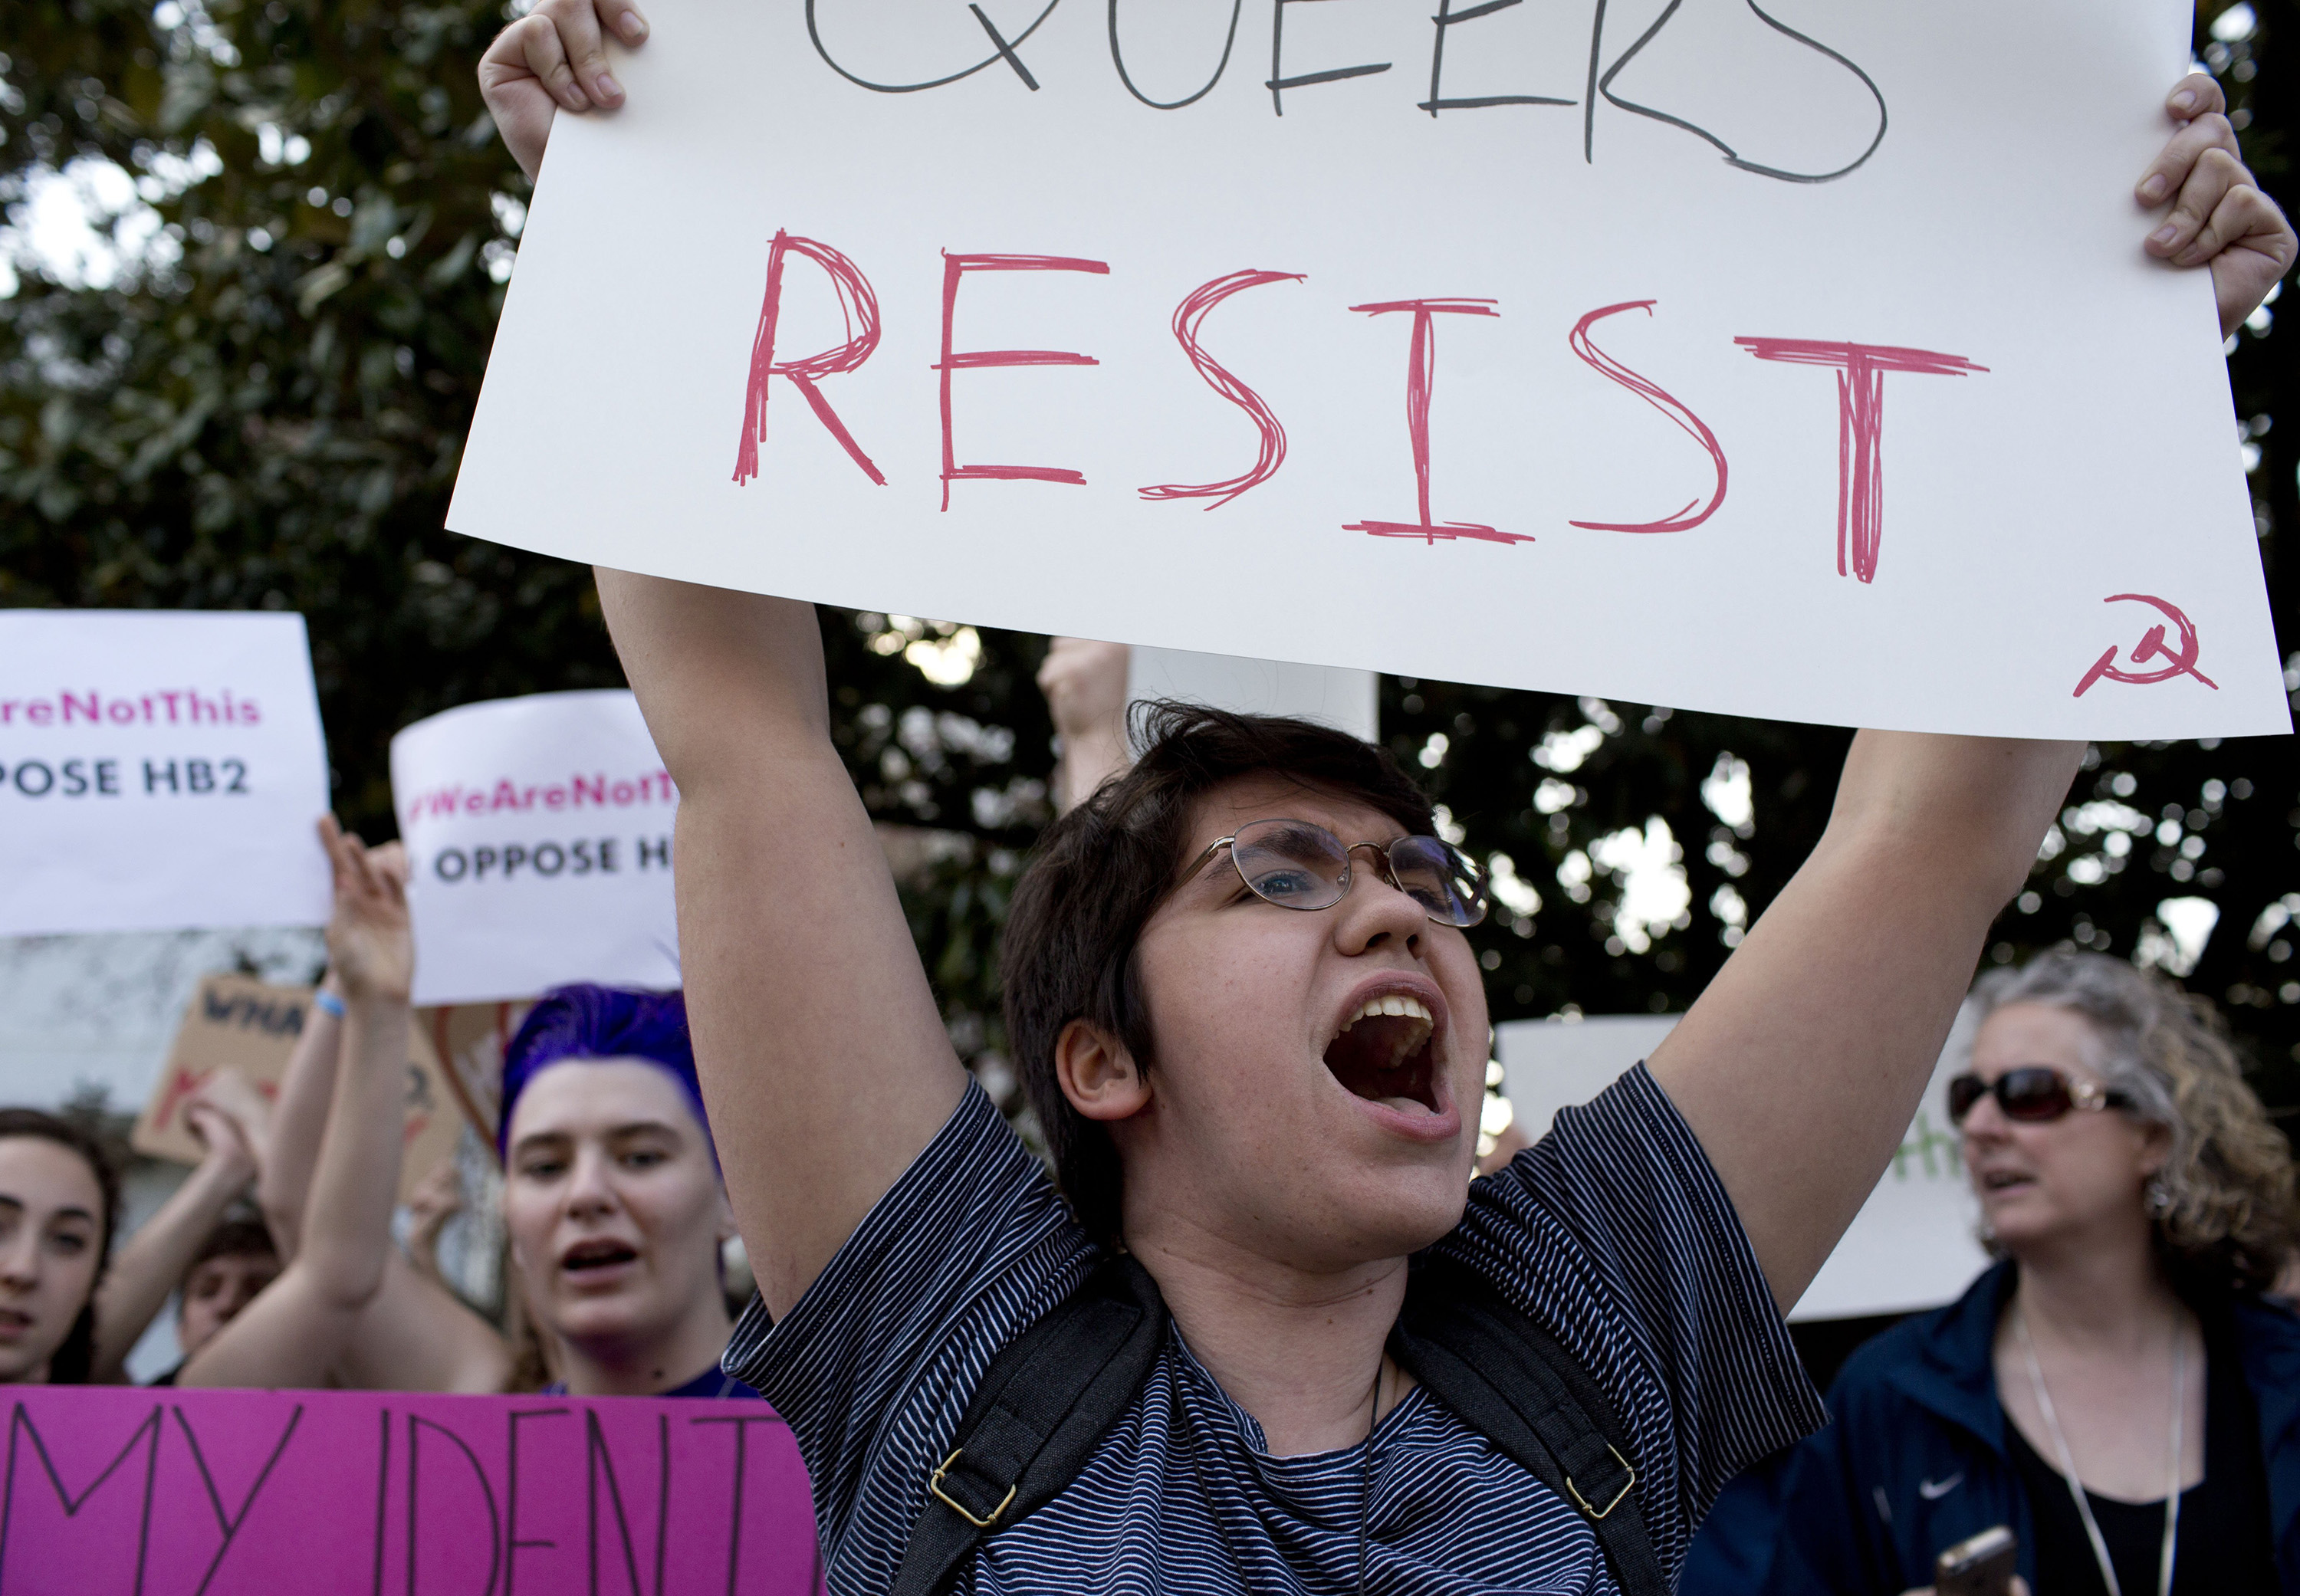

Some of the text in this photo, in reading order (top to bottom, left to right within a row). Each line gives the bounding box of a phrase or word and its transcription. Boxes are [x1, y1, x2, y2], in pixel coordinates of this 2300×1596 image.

[731, 228, 1991, 584] RESIST
[143, 757, 250, 796] HB2
[434, 837, 618, 885] OPPOSE
[0, 1403, 303, 1596] MY
